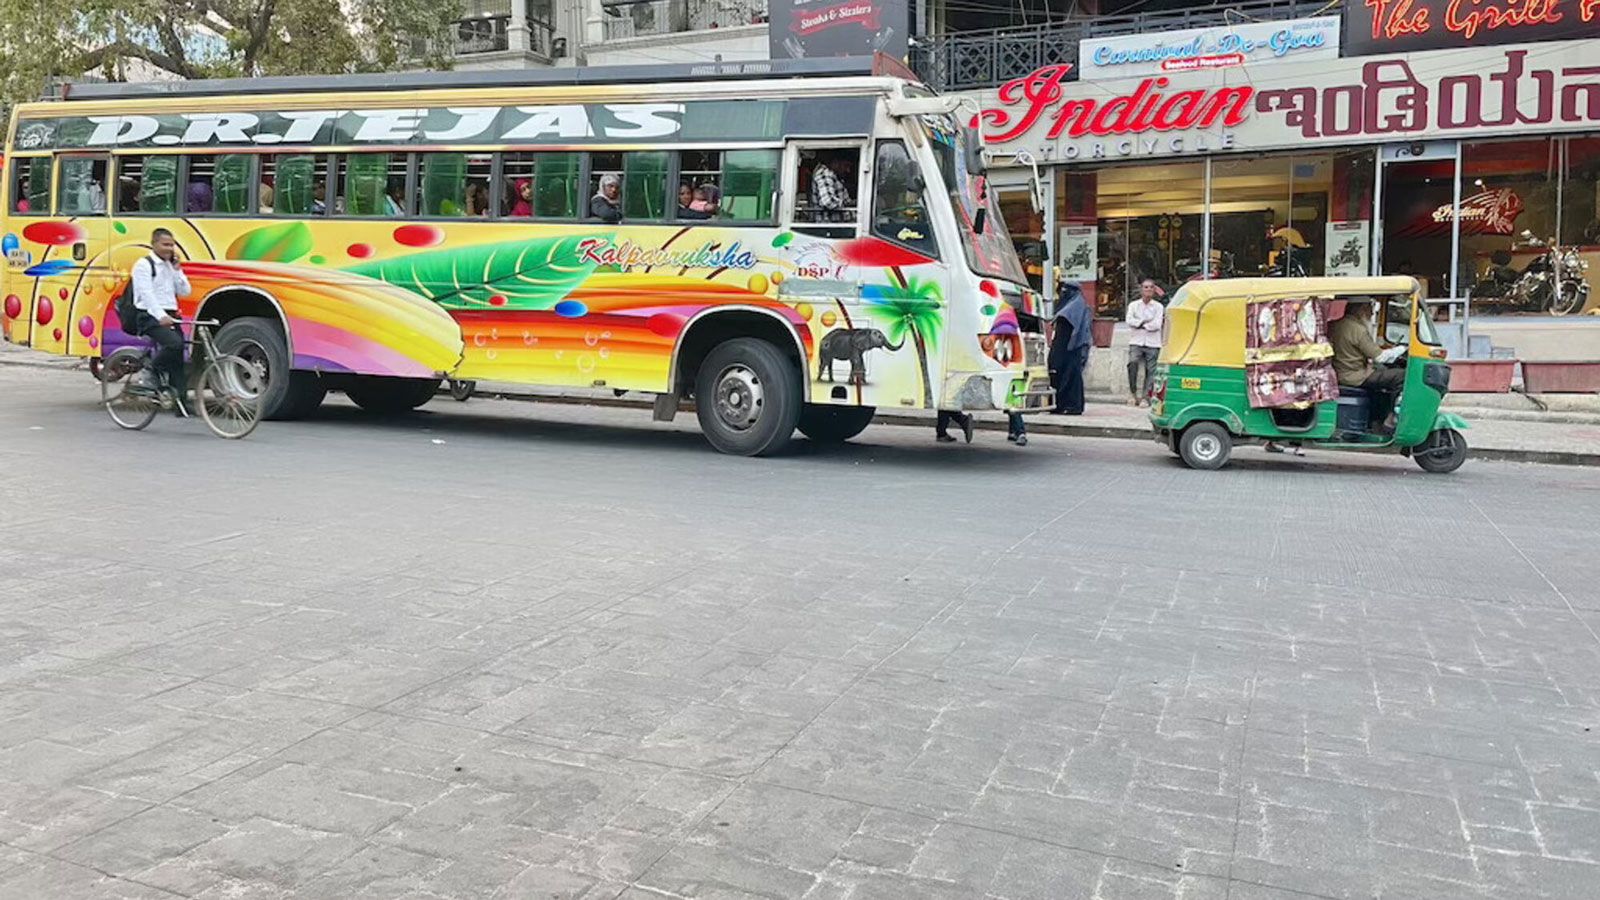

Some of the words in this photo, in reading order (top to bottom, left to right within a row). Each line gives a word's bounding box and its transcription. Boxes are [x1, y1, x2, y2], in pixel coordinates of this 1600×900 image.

[1367, 0, 1430, 39] The
[969, 63, 1255, 144] Indian
[1016, 134, 1235, 164] TORCYCLE
